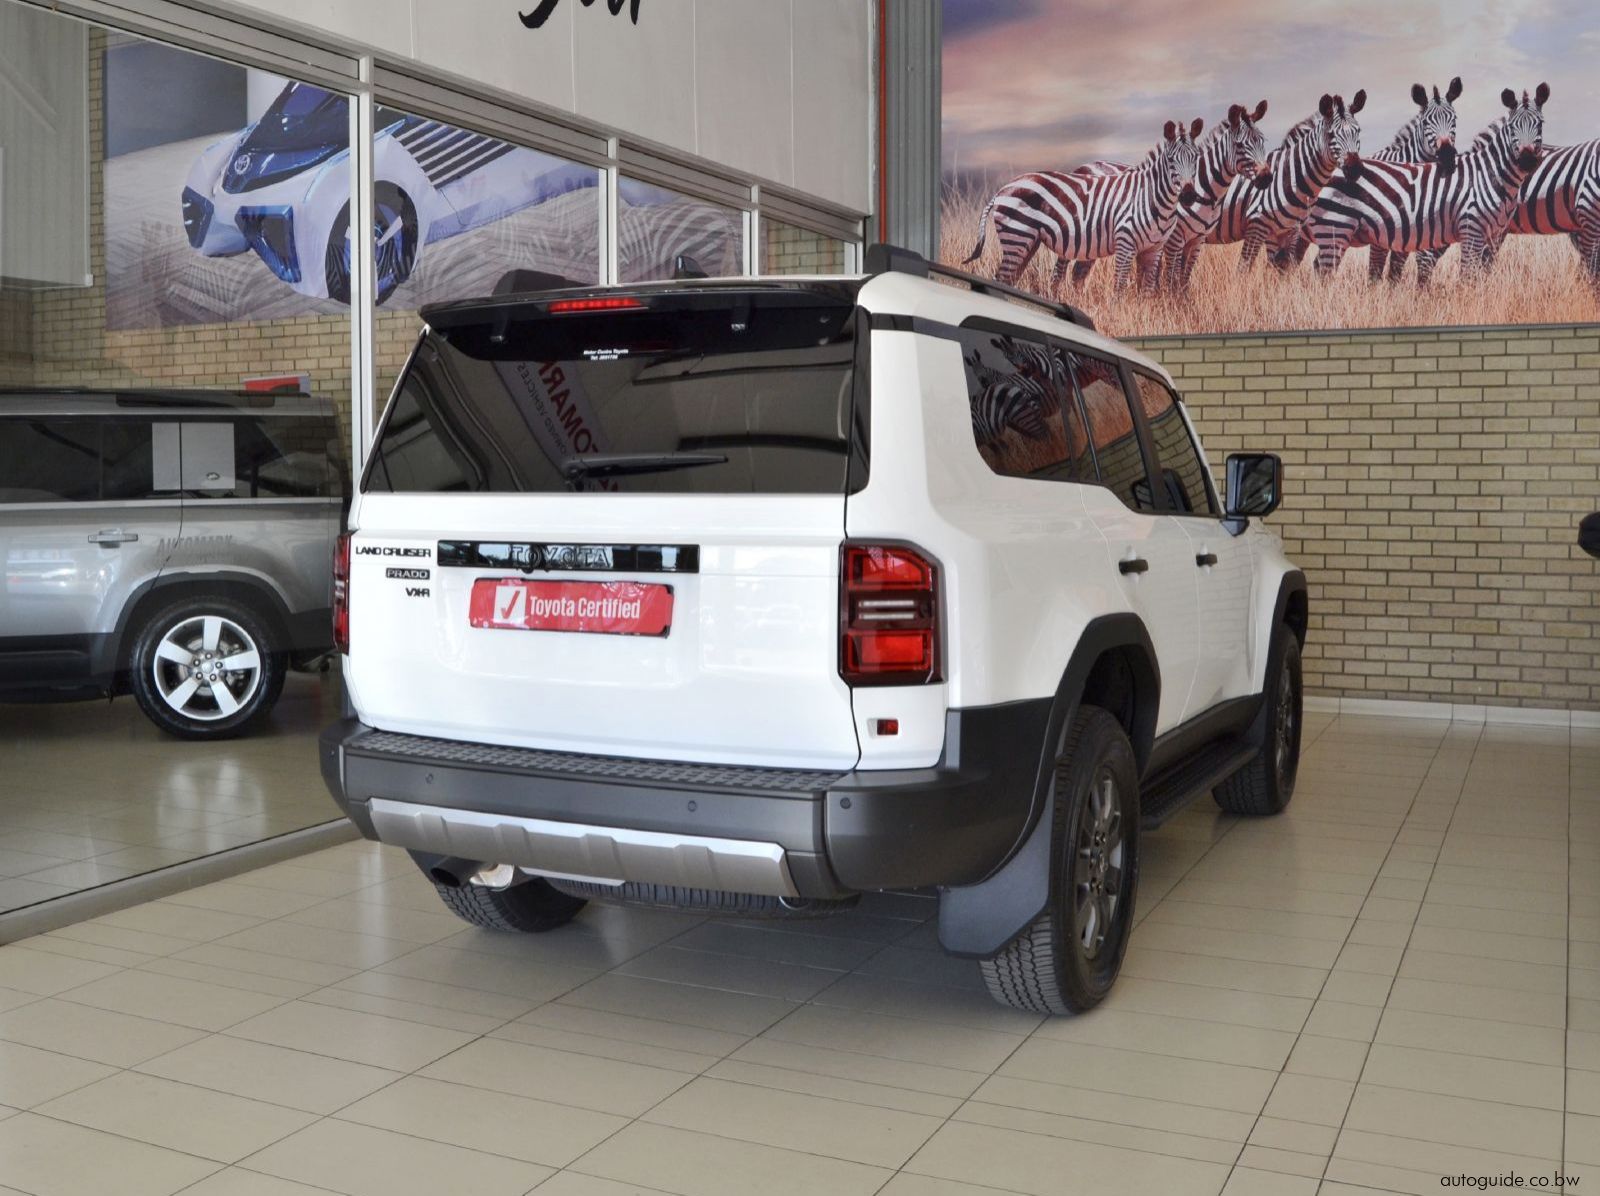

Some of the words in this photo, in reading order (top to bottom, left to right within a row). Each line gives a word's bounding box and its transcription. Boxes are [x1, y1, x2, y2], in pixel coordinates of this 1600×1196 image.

[355, 546, 382, 556] LAND
[383, 547, 431, 558] CRUISER
[510, 545, 612, 567] TOYOTA
[387, 568, 428, 579] PRADO
[530, 596, 575, 619] Toyota
[578, 596, 640, 619] Certified
